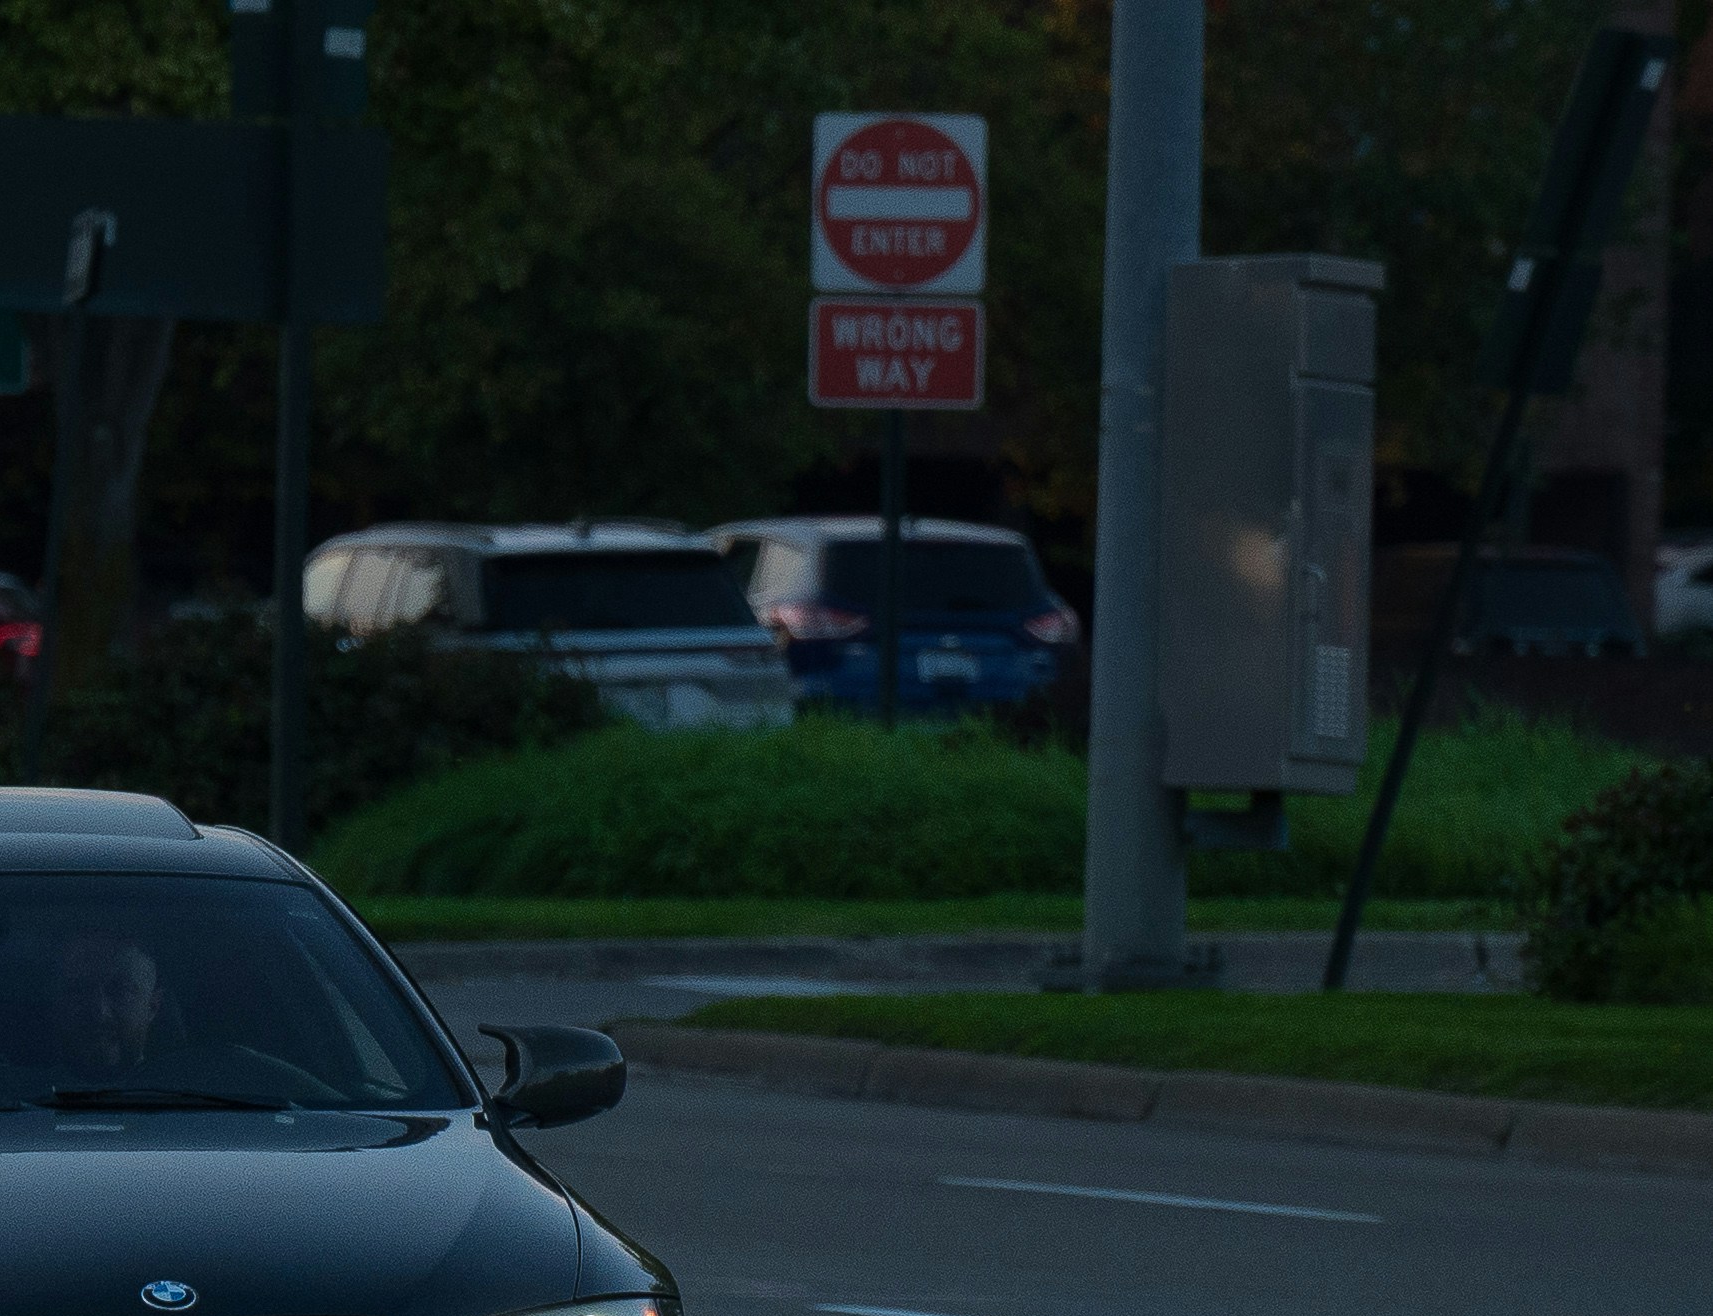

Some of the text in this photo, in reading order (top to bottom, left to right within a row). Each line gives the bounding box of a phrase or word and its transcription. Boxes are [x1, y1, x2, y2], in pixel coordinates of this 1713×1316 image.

[839, 149, 958, 182] DO NOT
[850, 225, 946, 257] ENTER
[832, 313, 964, 353] WRONG
[855, 355, 937, 394] WAY
